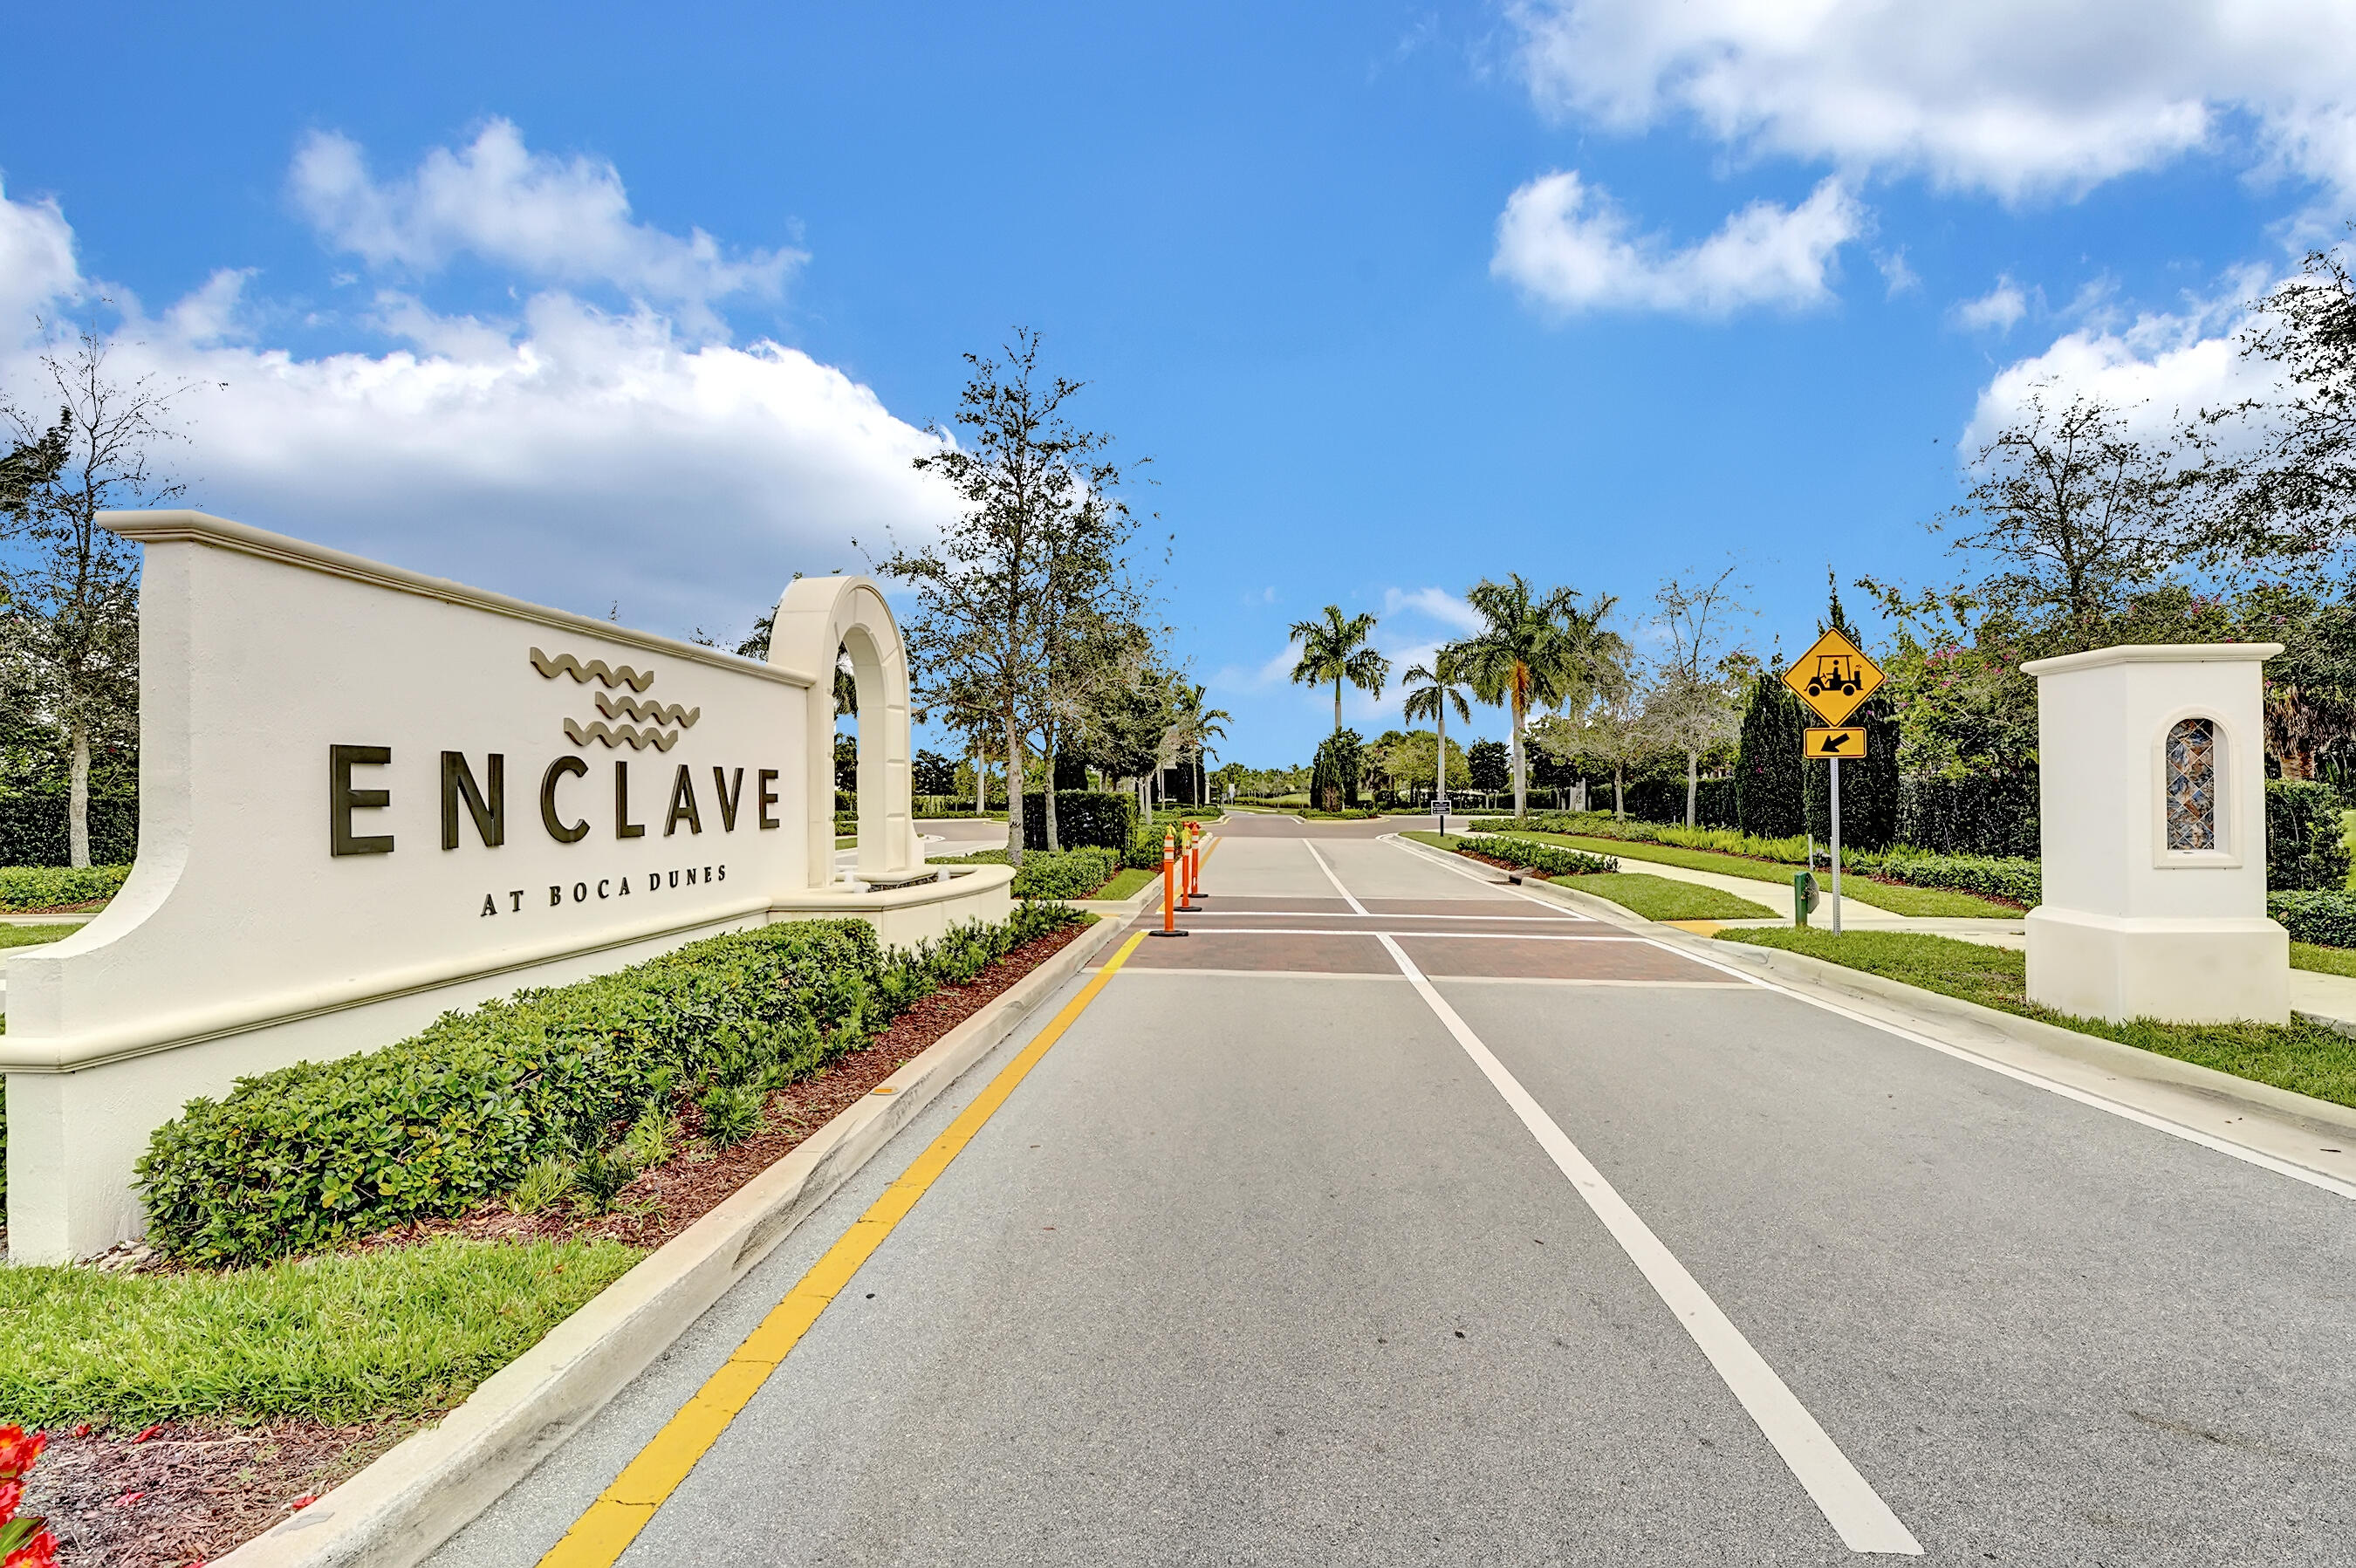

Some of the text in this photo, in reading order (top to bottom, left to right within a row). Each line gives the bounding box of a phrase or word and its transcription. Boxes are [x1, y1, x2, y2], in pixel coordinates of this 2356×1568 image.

[330, 743, 780, 857] ENCLAVE
[480, 864, 727, 917] AT BOCA DUNES
